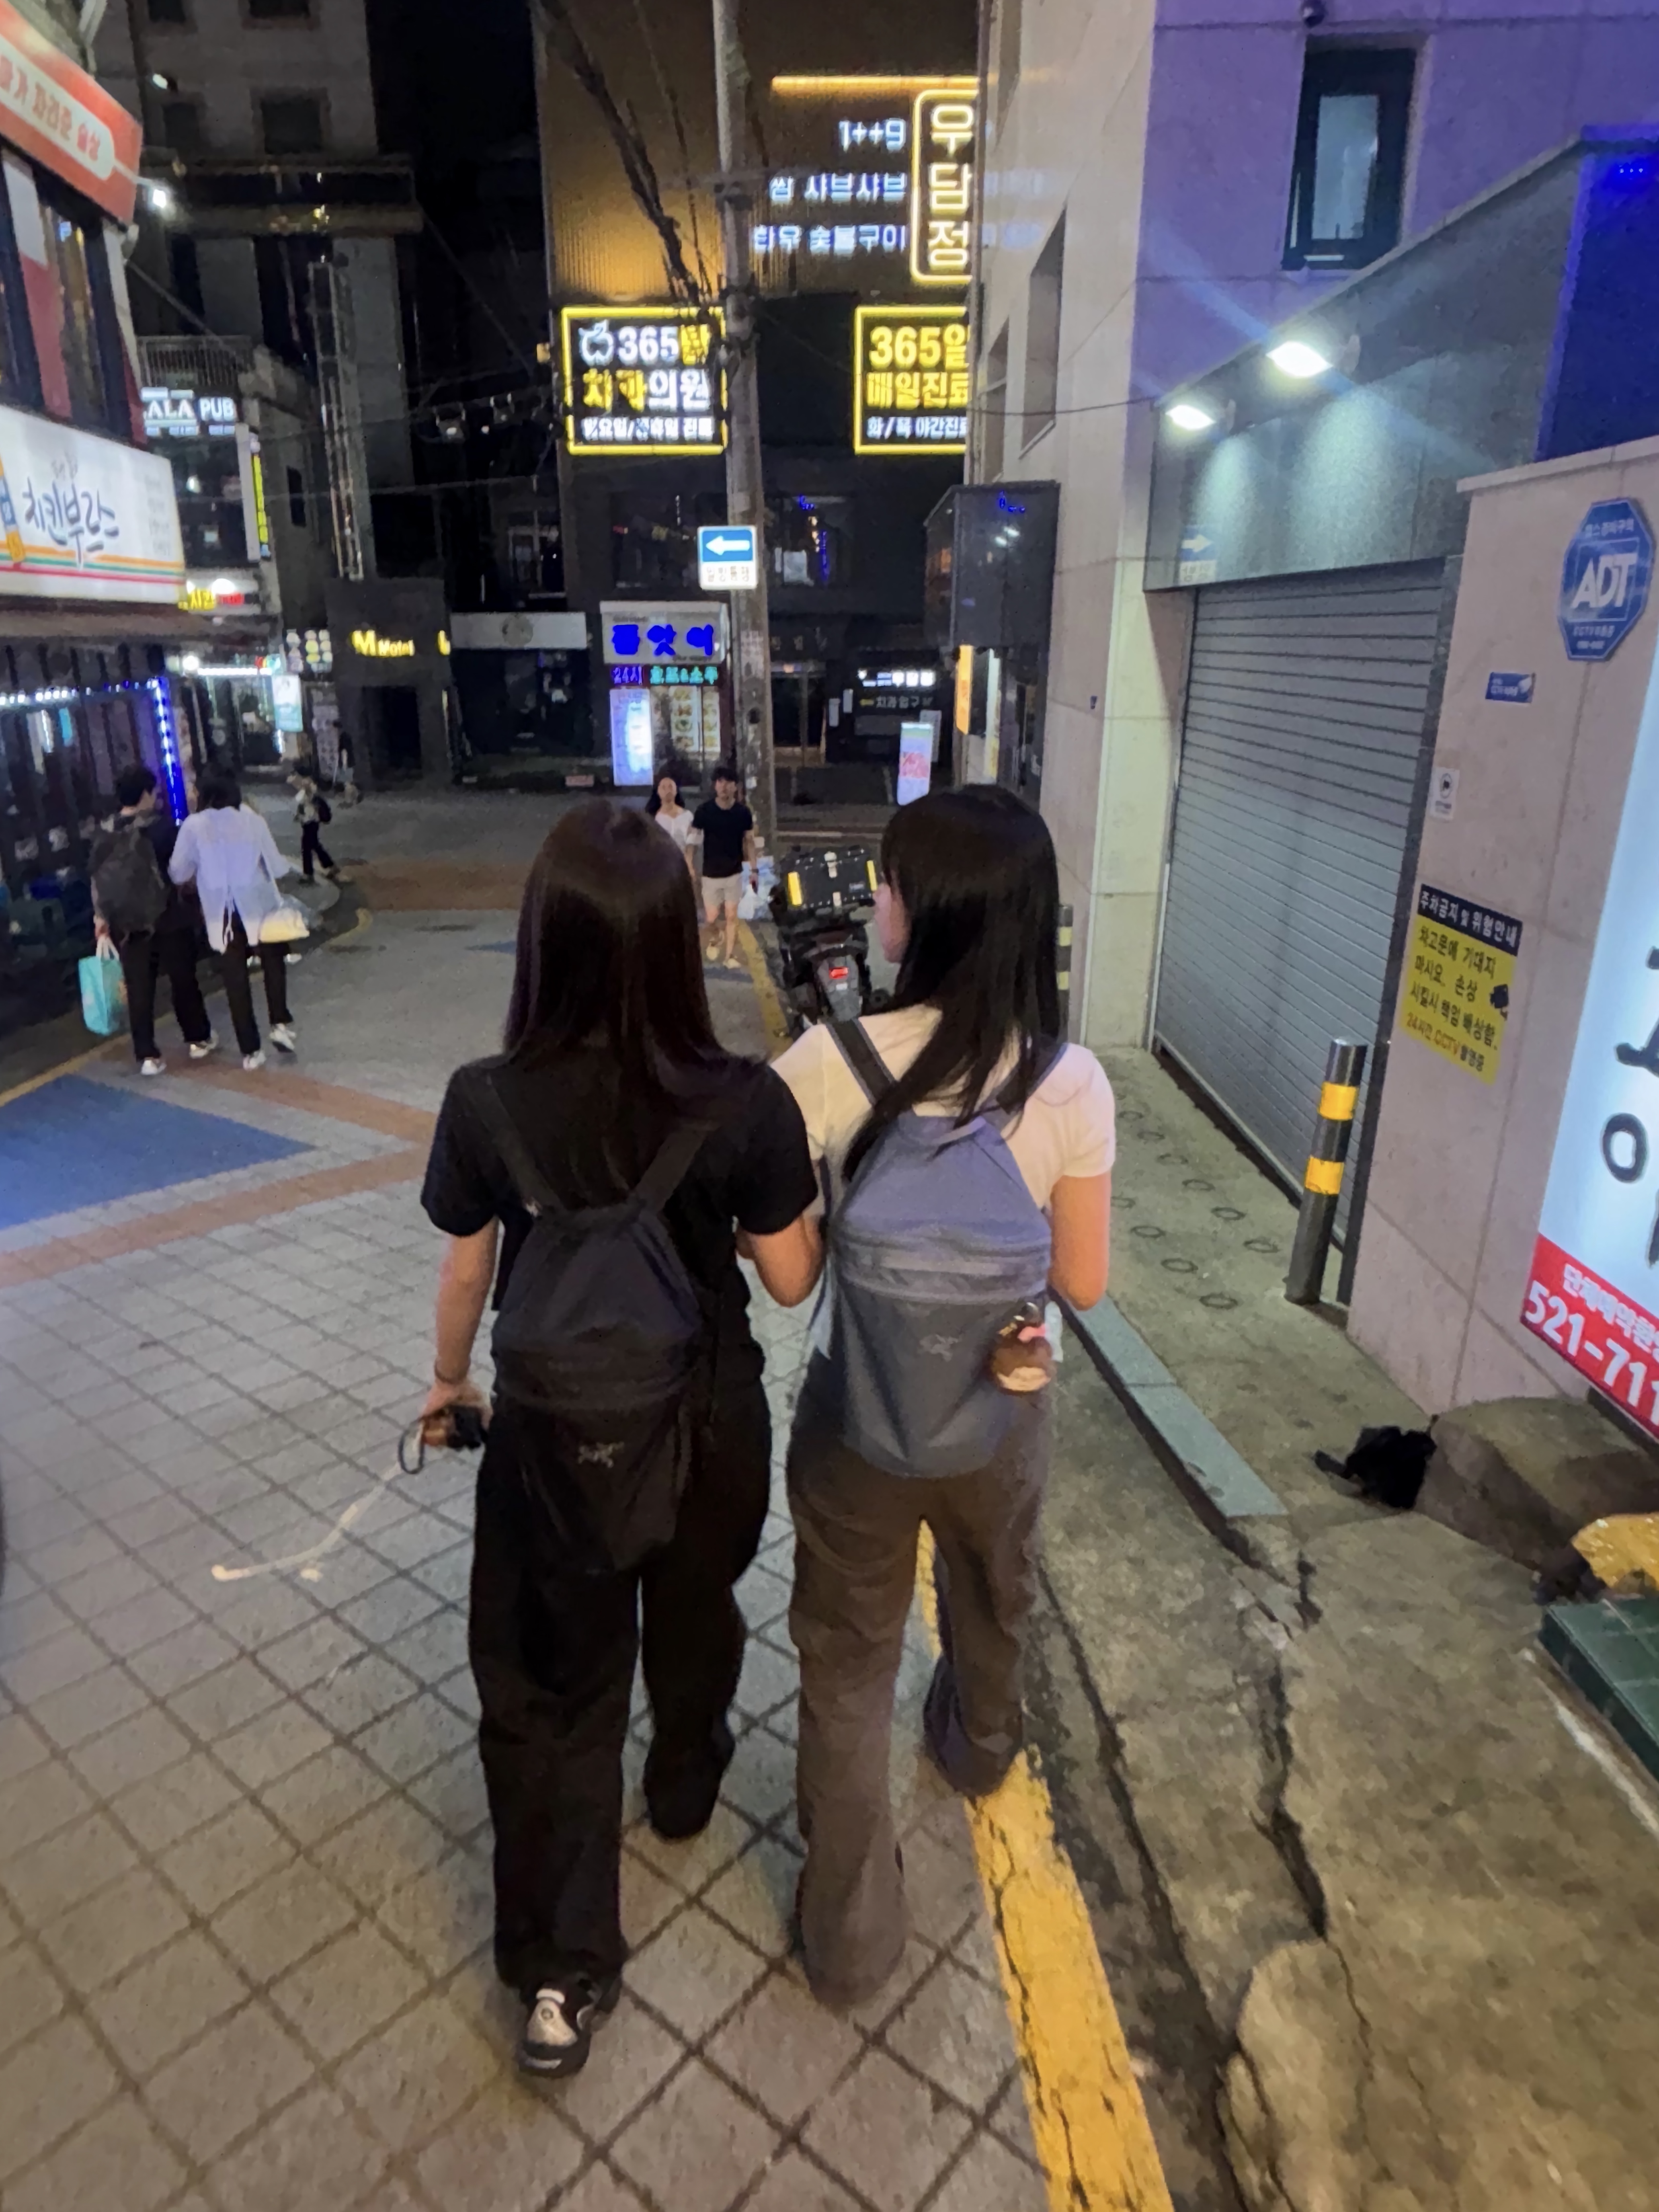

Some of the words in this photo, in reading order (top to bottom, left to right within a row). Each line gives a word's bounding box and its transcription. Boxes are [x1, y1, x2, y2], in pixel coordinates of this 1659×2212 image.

[839, 118, 906, 151] 1++9
[805, 172, 906, 203] 샤브샤브
[929, 105, 974, 270] 우담정
[869, 324, 970, 369] 365일
[867, 372, 969, 409] 매일진료
[143, 398, 197, 420] ALA
[199, 396, 236, 421] PUB
[1571, 552, 1638, 609] ADT
[352, 630, 377, 656] M
[1421, 891, 1459, 923] 주차금지
[1455, 975, 1477, 1003] 손상
